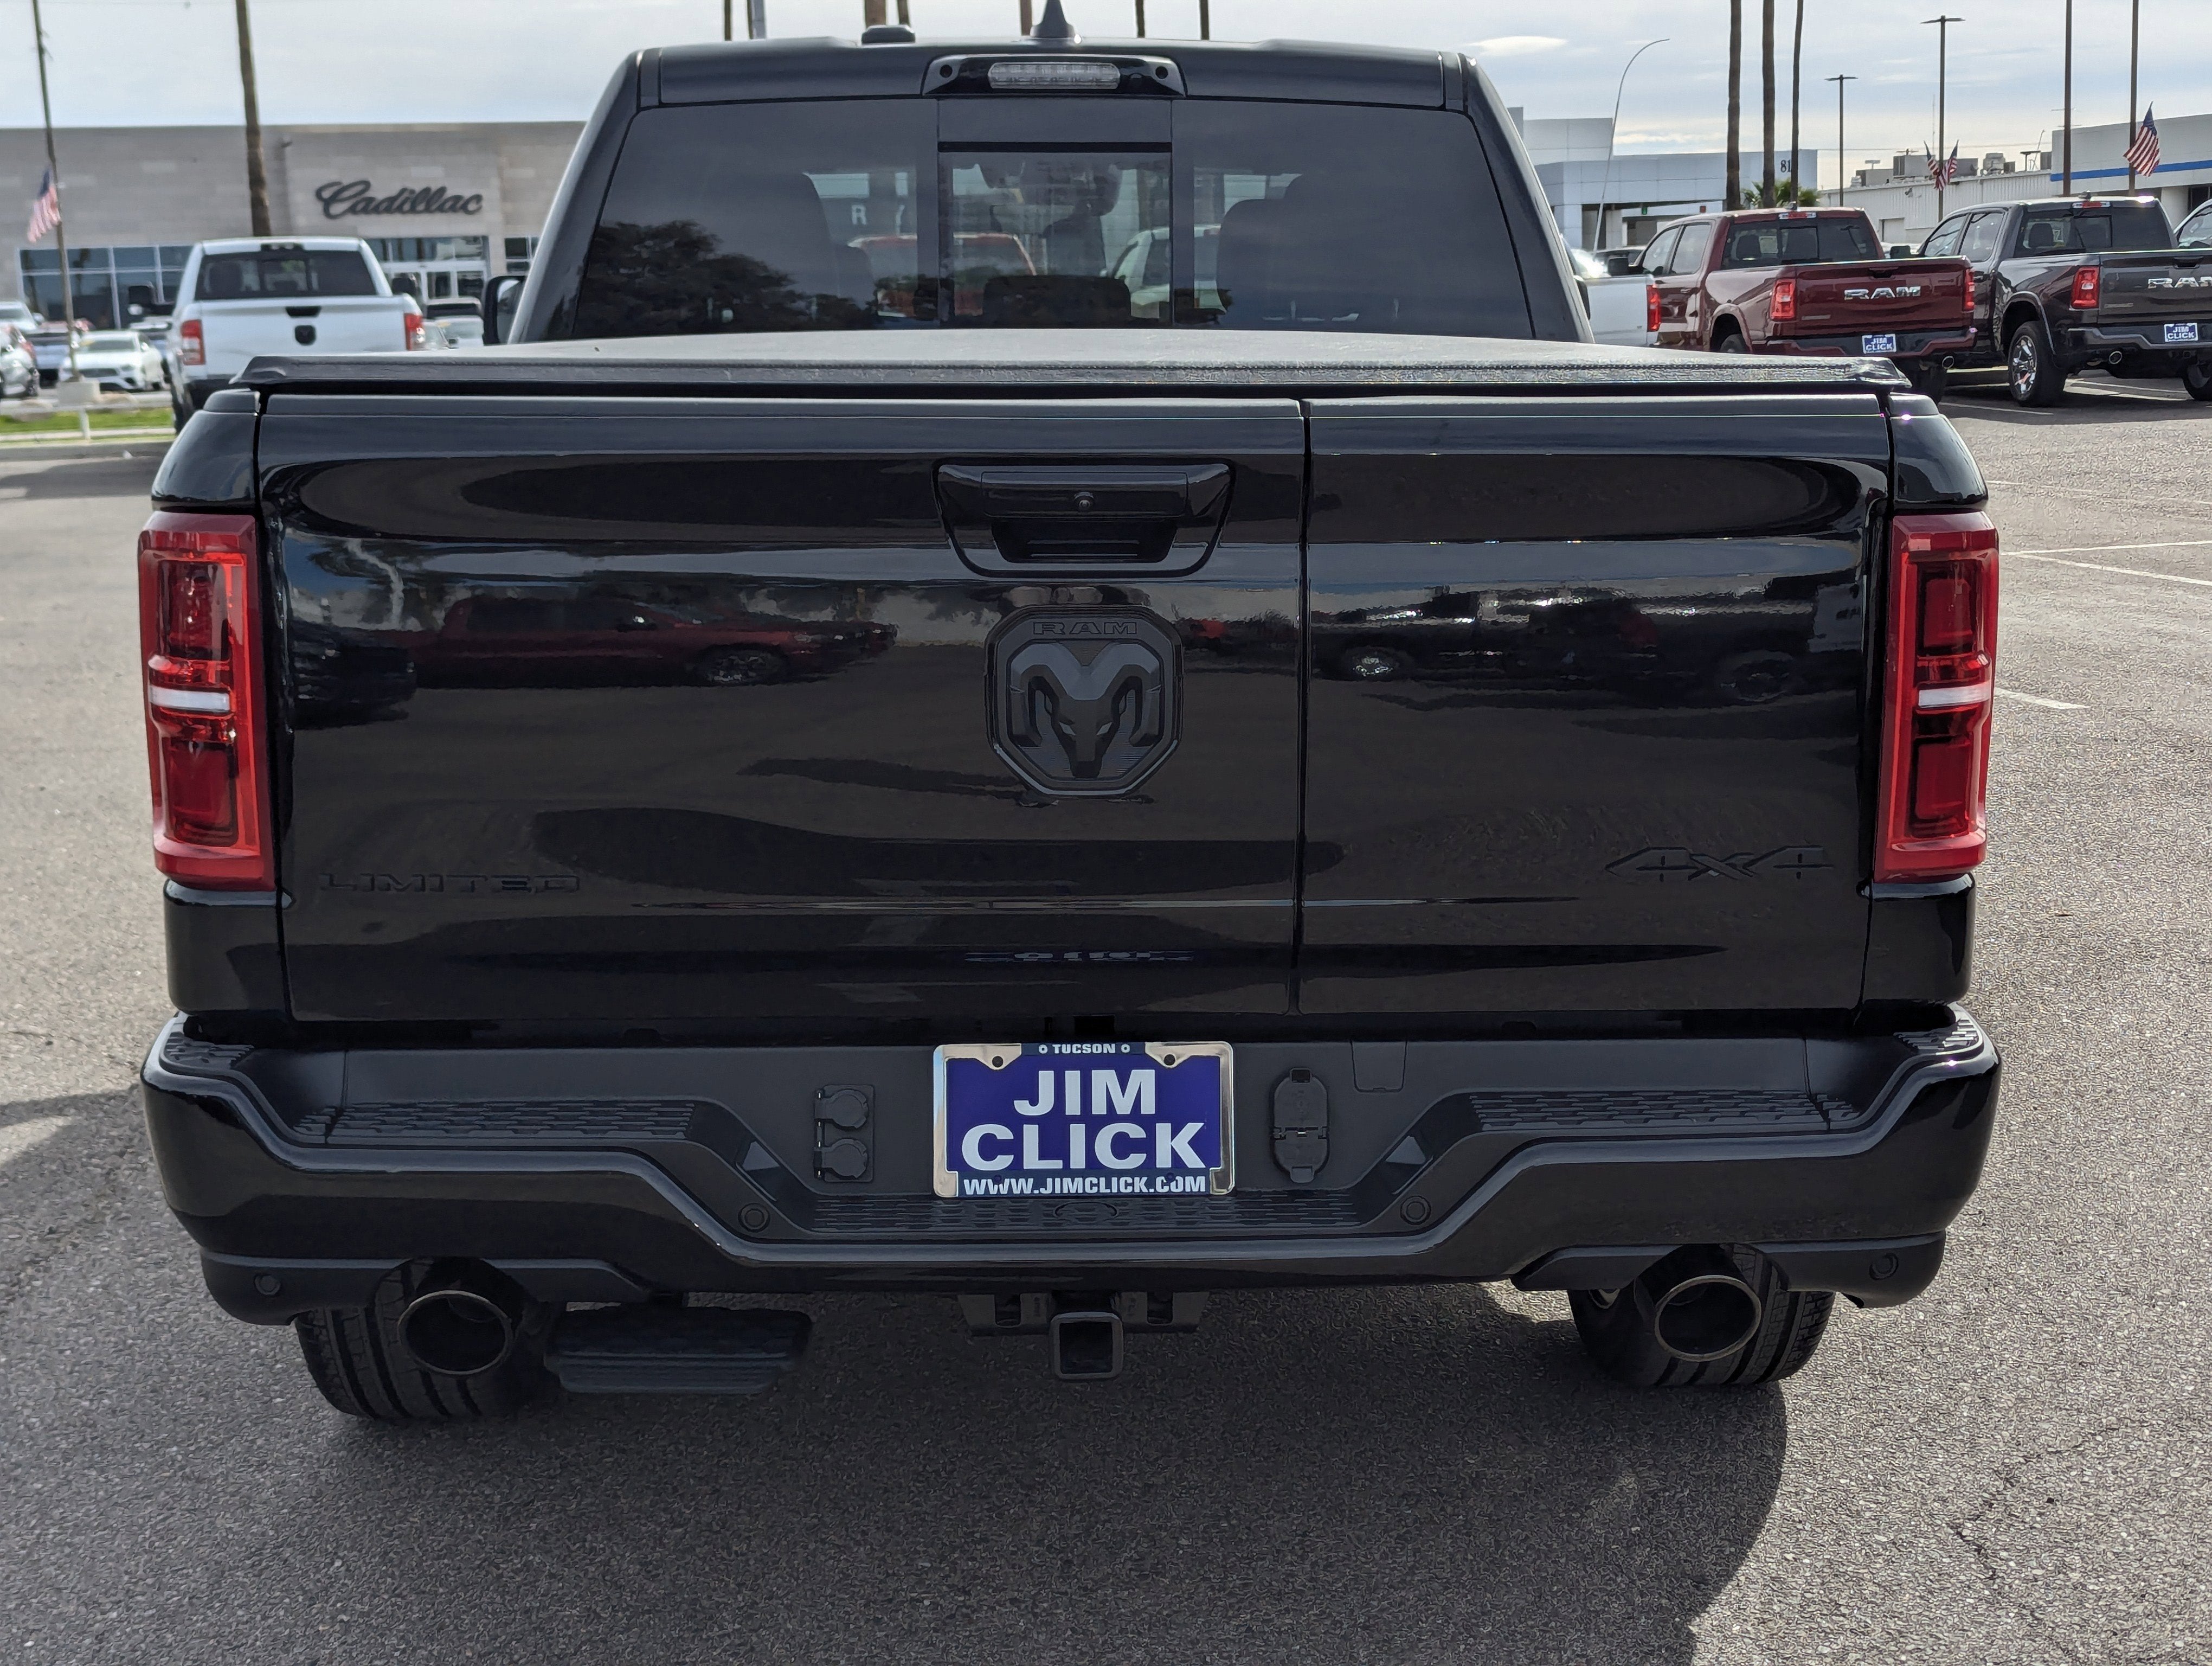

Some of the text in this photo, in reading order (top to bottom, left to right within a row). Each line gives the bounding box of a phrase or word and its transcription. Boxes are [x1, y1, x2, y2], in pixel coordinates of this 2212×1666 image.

[315, 180, 483, 220] Cadillac
[1844, 285, 1921, 300] RAM
[2168, 331, 2195, 339] CLICK
[1866, 342, 1893, 351] CLICK
[1033, 621, 1137, 635] RAM
[318, 872, 581, 893] LIMITED
[1052, 1043, 1116, 1054] TUCSON
[1014, 1069, 1155, 1116] JIM
[962, 1123, 1206, 1170] CLICK
[963, 1176, 1206, 1195] WWW.JIMCLICK.COM
